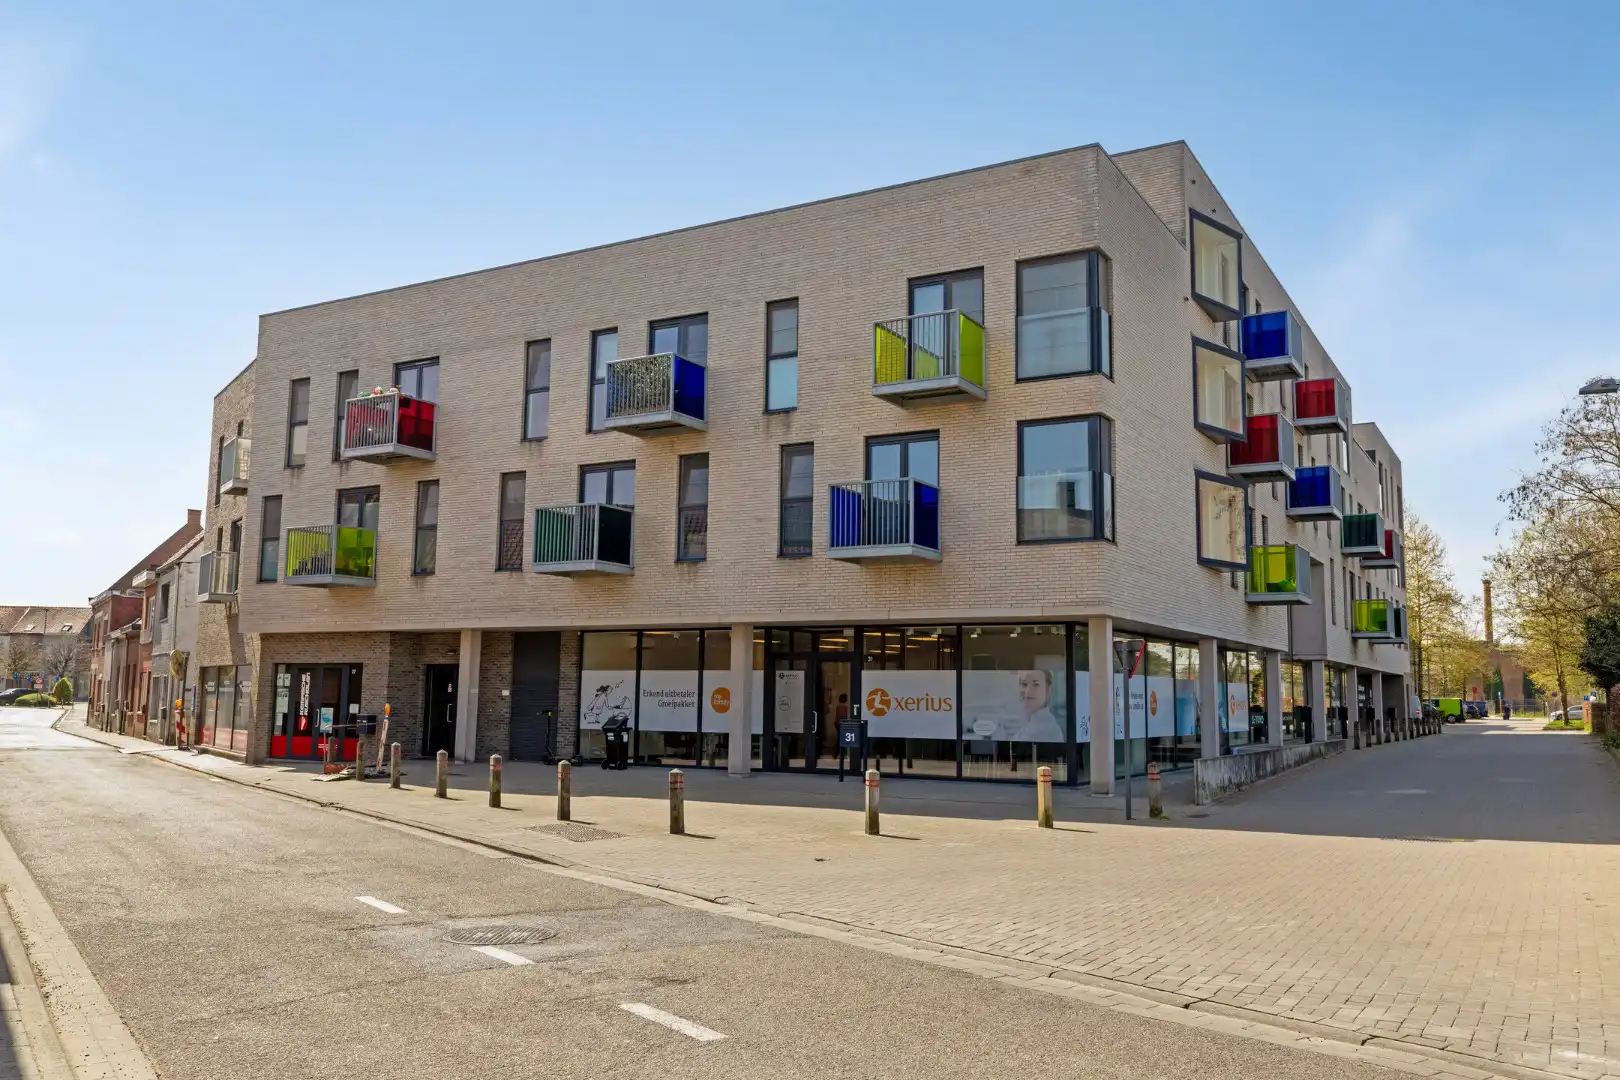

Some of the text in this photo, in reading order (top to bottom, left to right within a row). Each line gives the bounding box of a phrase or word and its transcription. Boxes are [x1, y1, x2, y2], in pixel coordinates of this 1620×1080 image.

[643, 689, 696, 698] Erkend uitbetaler
[657, 699, 695, 709] Groeipakket
[894, 692, 953, 712] xerius
[845, 732, 855, 742] 31
